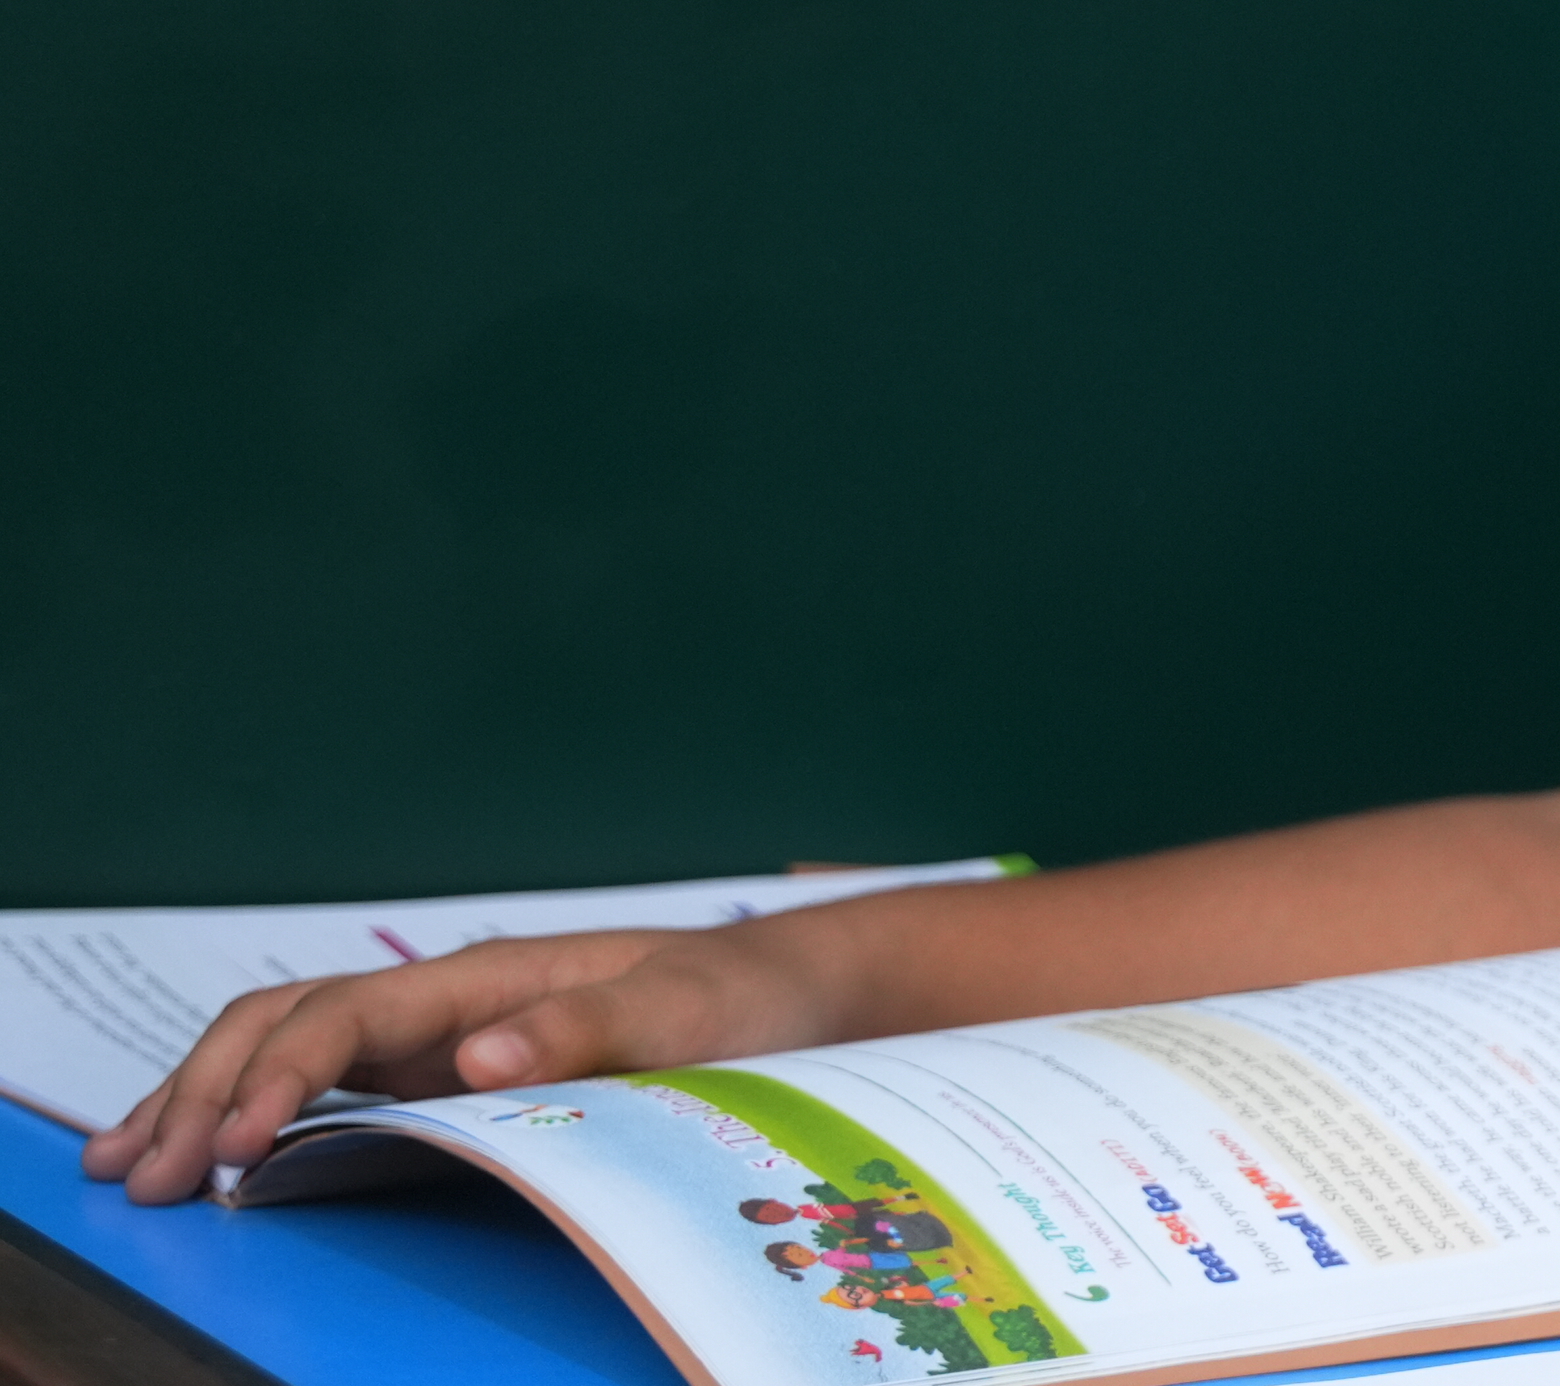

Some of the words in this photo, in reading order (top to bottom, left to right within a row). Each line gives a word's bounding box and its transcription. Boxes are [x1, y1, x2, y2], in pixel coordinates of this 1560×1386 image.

[1176, 1165, 1216, 1191] feel
[996, 1181, 1067, 1242] Thought
[1050, 1188, 1090, 1219] inside
[1136, 1183, 1183, 1213] Go
[1207, 1191, 1246, 1217] you
[1085, 1221, 1114, 1246] voice
[1153, 1211, 1200, 1245] Set
[1276, 1211, 1349, 1269] Read
[1336, 1203, 1394, 1259] William
[1056, 1245, 1098, 1275] Key
[1104, 1247, 1132, 1268] The
[1184, 1243, 1240, 1285] Get
[1249, 1240, 1290, 1275] How
